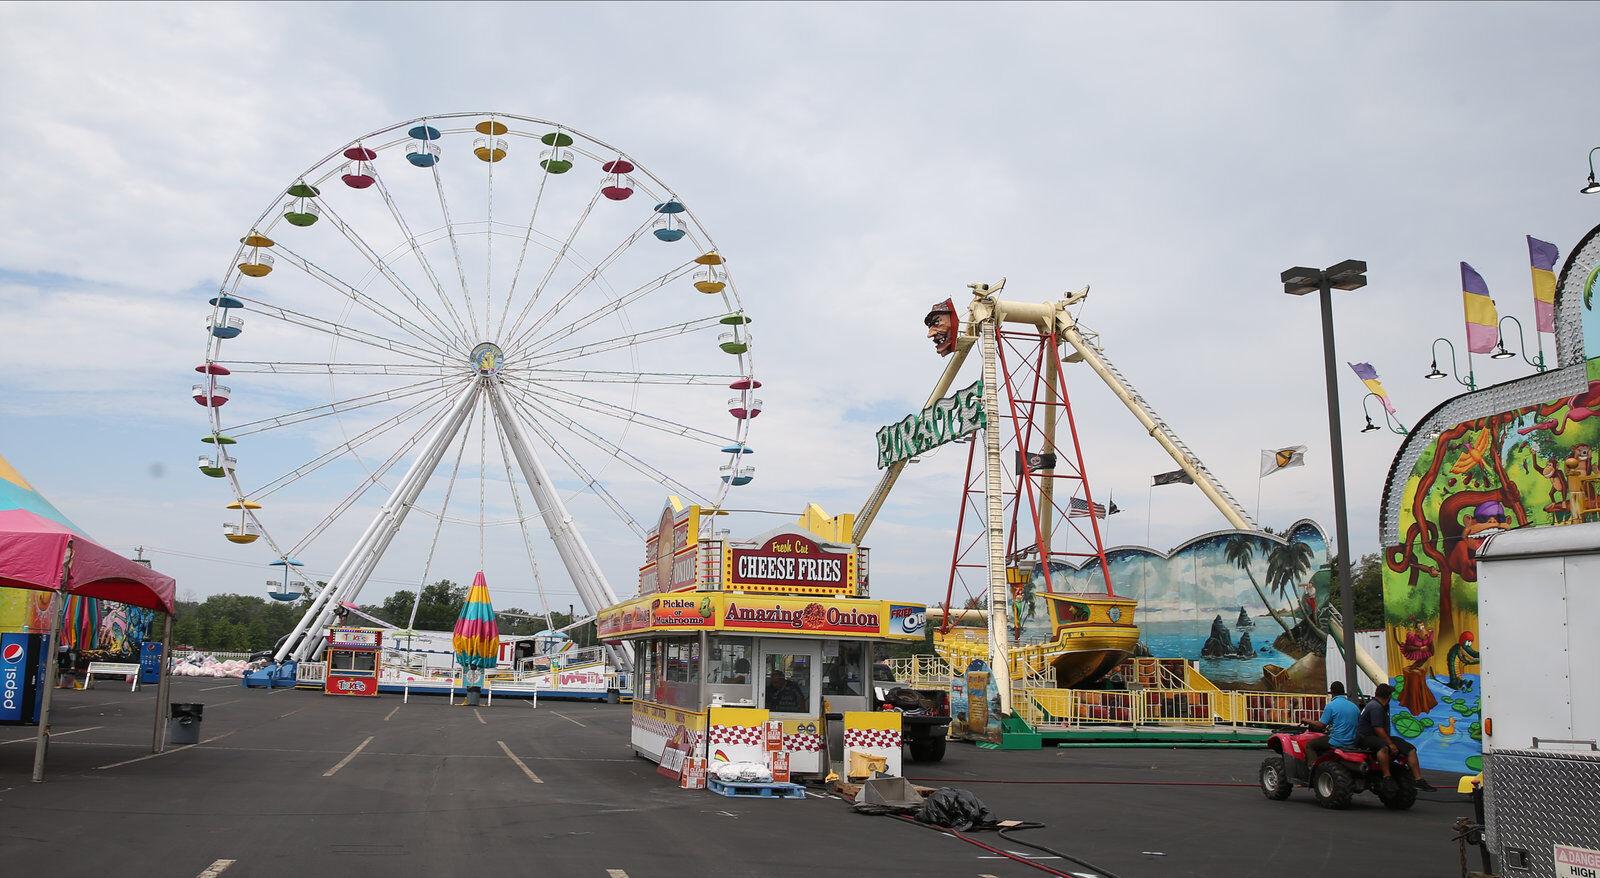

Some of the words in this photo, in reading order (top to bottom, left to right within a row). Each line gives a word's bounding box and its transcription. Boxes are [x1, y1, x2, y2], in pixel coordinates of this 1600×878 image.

[876, 380, 988, 470] PIRATE
[772, 540, 792, 553] Fresh
[795, 540, 810, 554] Cut
[738, 555, 795, 580] CHEESE
[798, 558, 841, 582] FRIES
[663, 600, 694, 608] Pickles
[725, 602, 804, 627] Amazing
[826, 607, 879, 626] Onion
[891, 608, 913, 619] FRIED
[656, 617, 704, 625] Mushrooms
[4, 666, 19, 709] pepsi
[1570, 866, 1597, 878] HIGH
